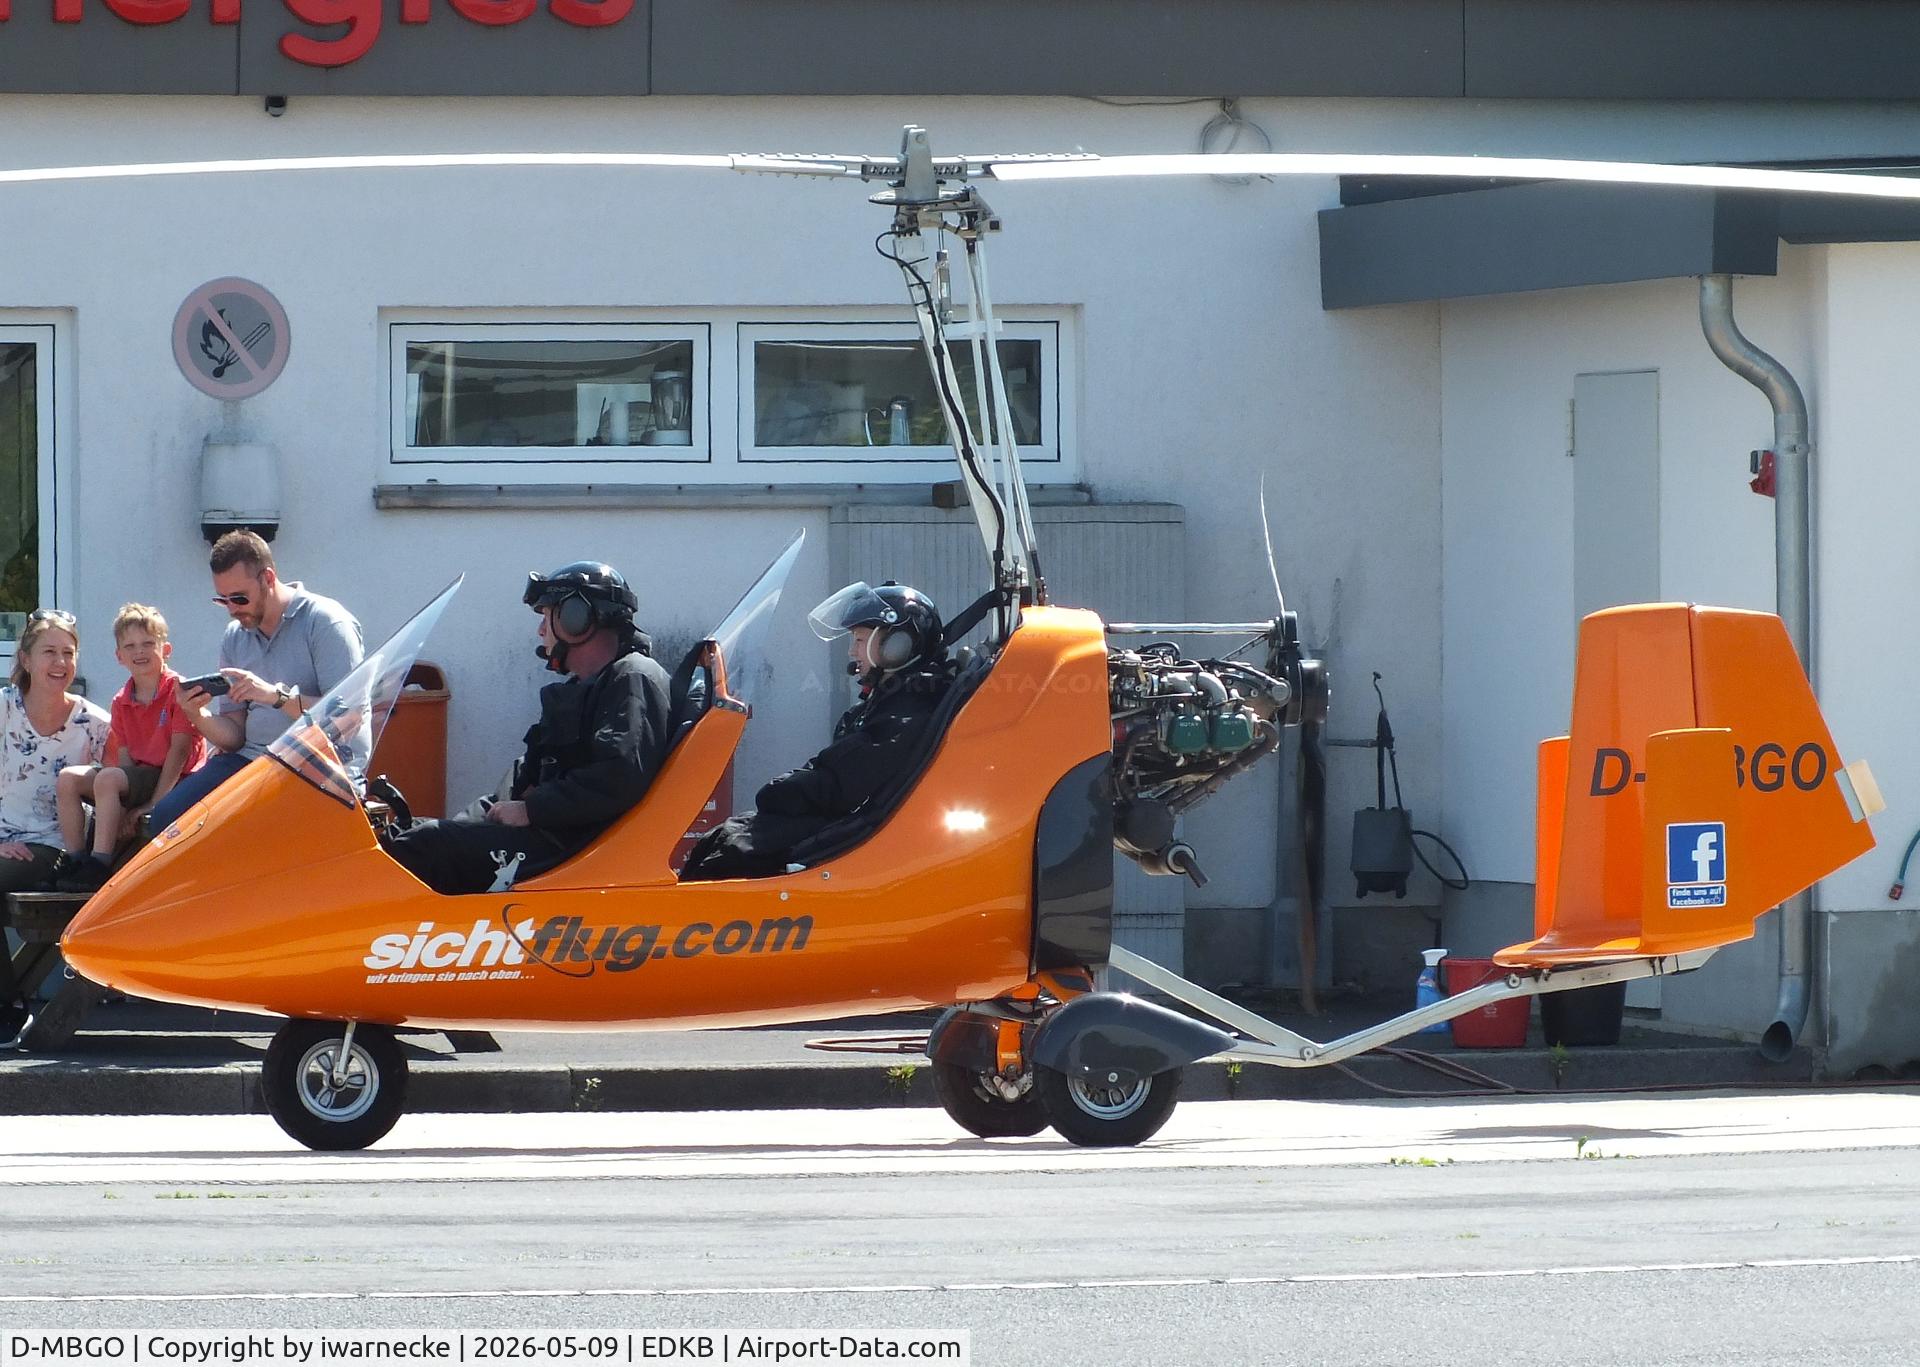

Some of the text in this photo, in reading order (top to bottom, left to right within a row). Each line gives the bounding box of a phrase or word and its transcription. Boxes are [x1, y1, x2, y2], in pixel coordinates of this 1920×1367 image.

[366, 974, 388, 984] wir
[387, 972, 434, 984] bringen
[436, 970, 457, 982] sie
[457, 970, 488, 980] nach
